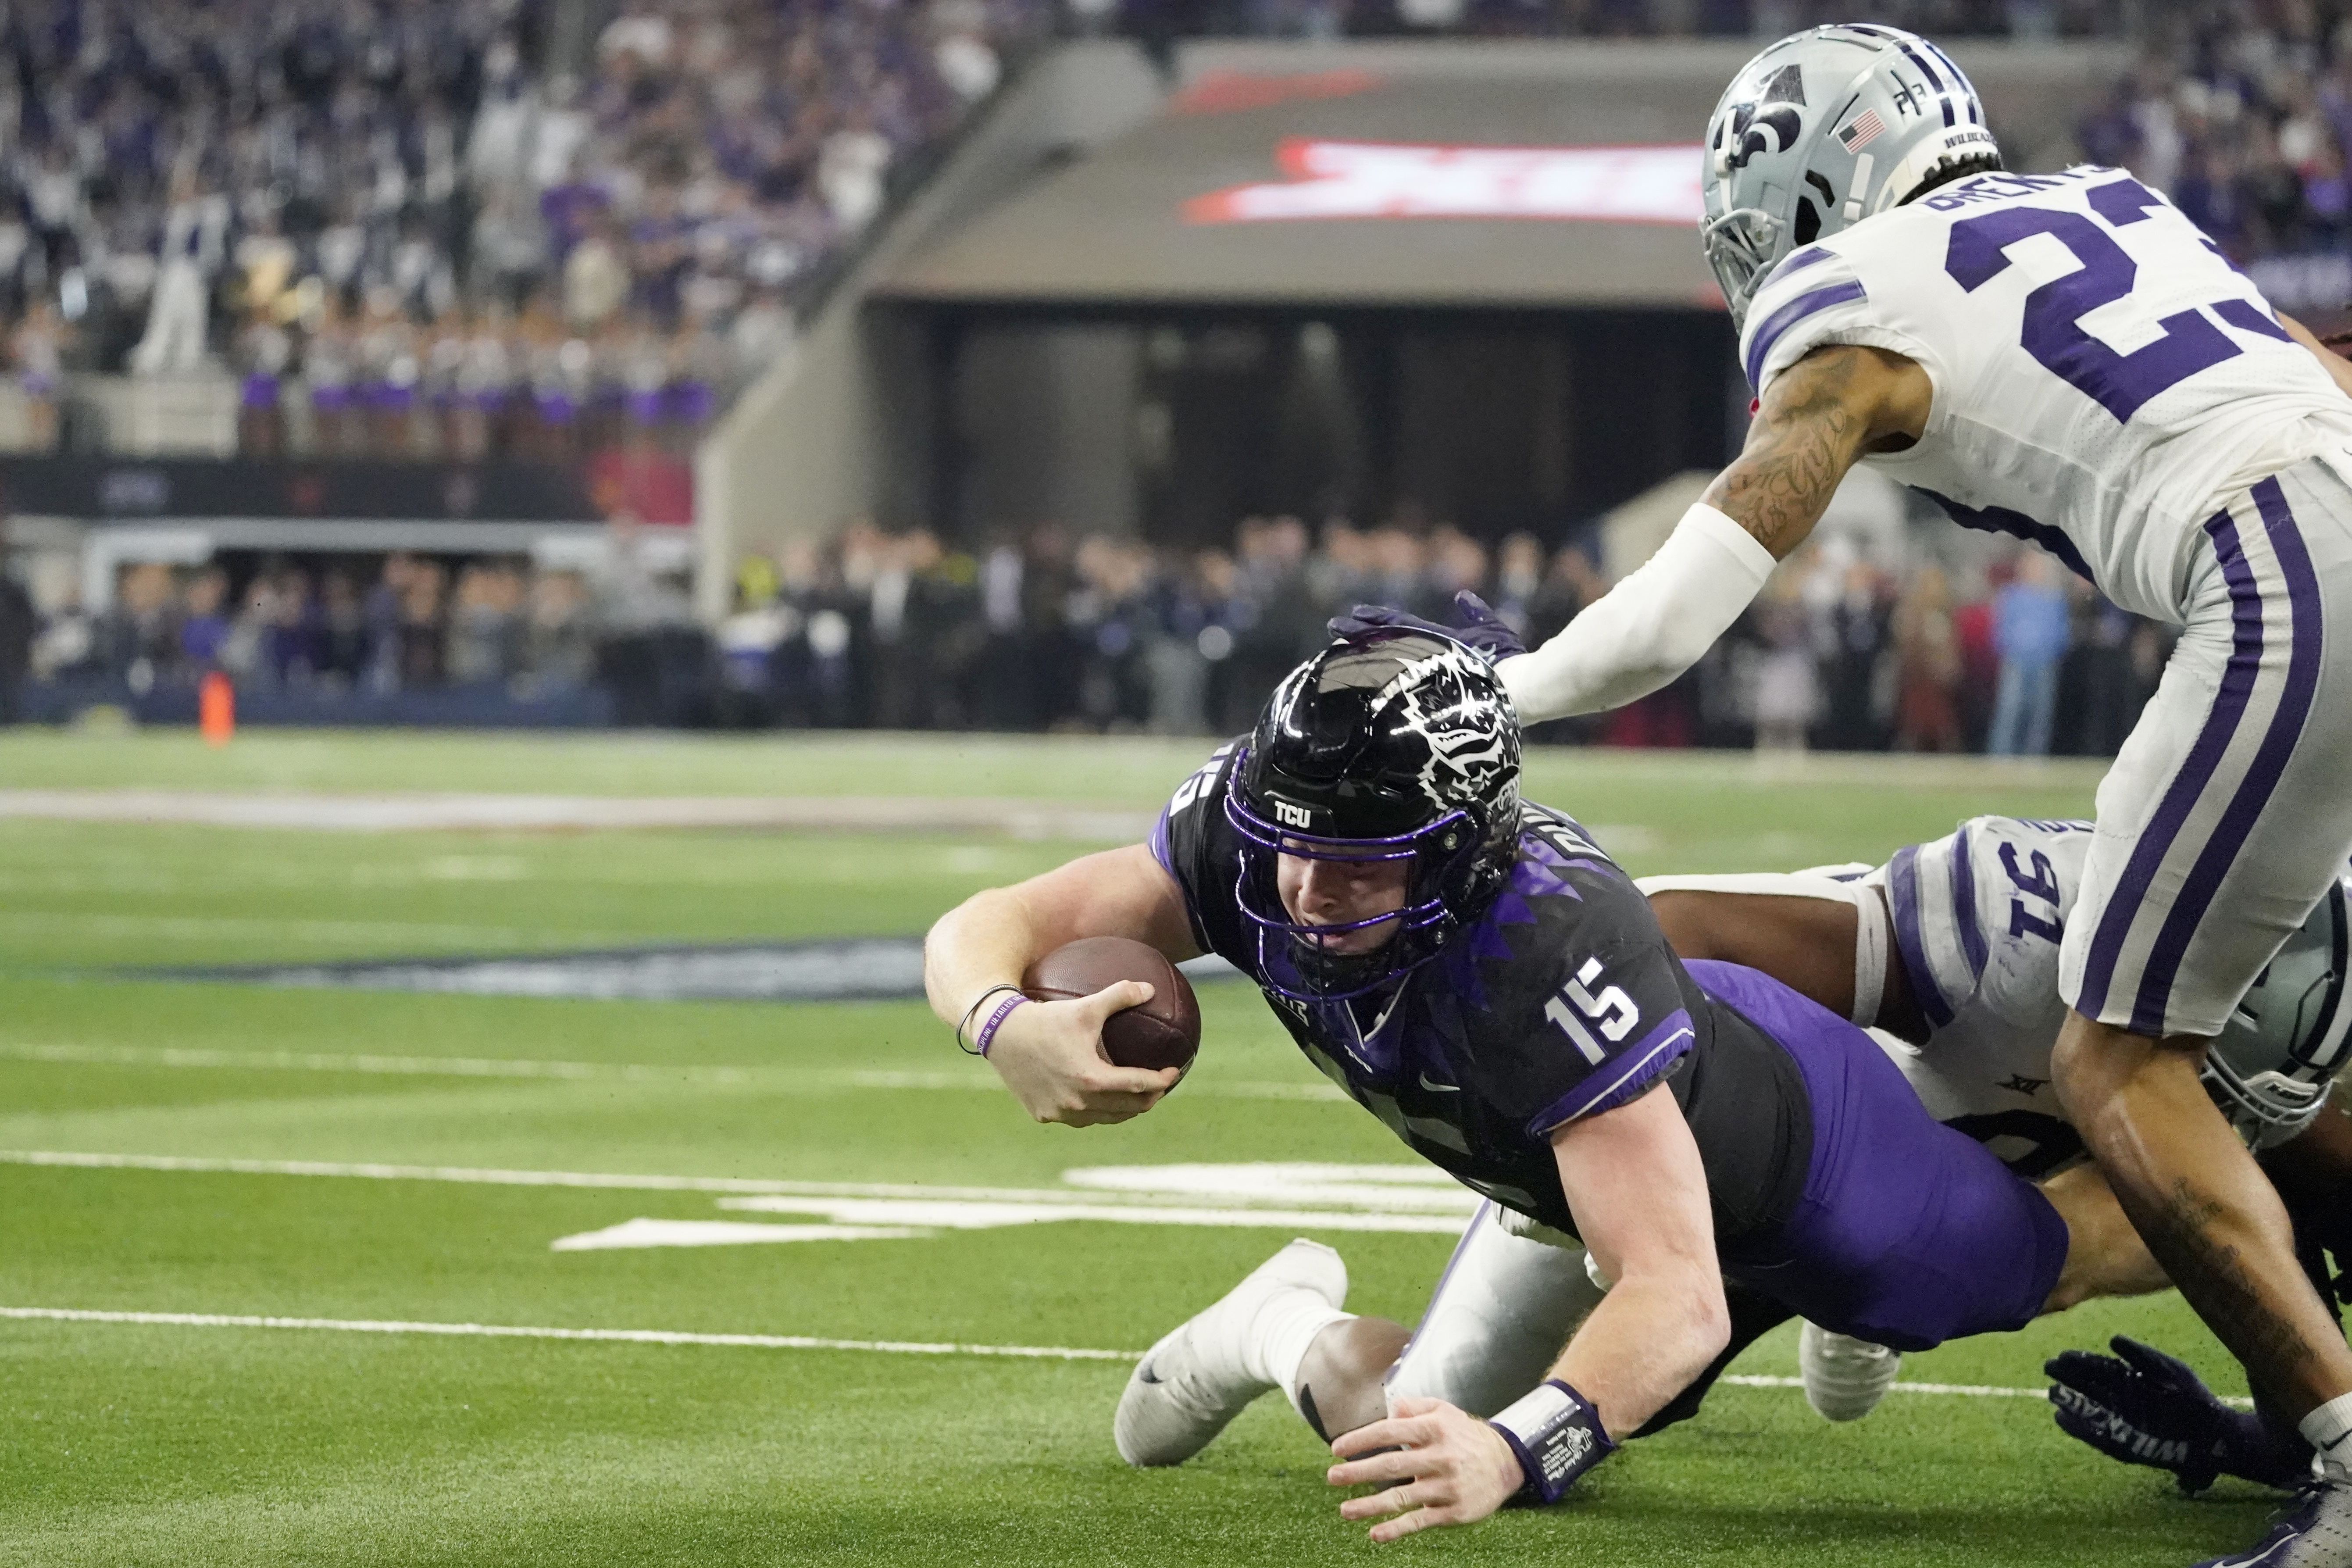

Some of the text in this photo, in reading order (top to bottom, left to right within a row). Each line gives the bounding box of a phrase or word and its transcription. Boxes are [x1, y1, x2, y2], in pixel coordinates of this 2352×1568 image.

[1945, 178, 2297, 425] 23
[1274, 800, 1311, 829] TCU
[1998, 840, 2064, 945] 91
[1544, 956, 1640, 1066] 15
